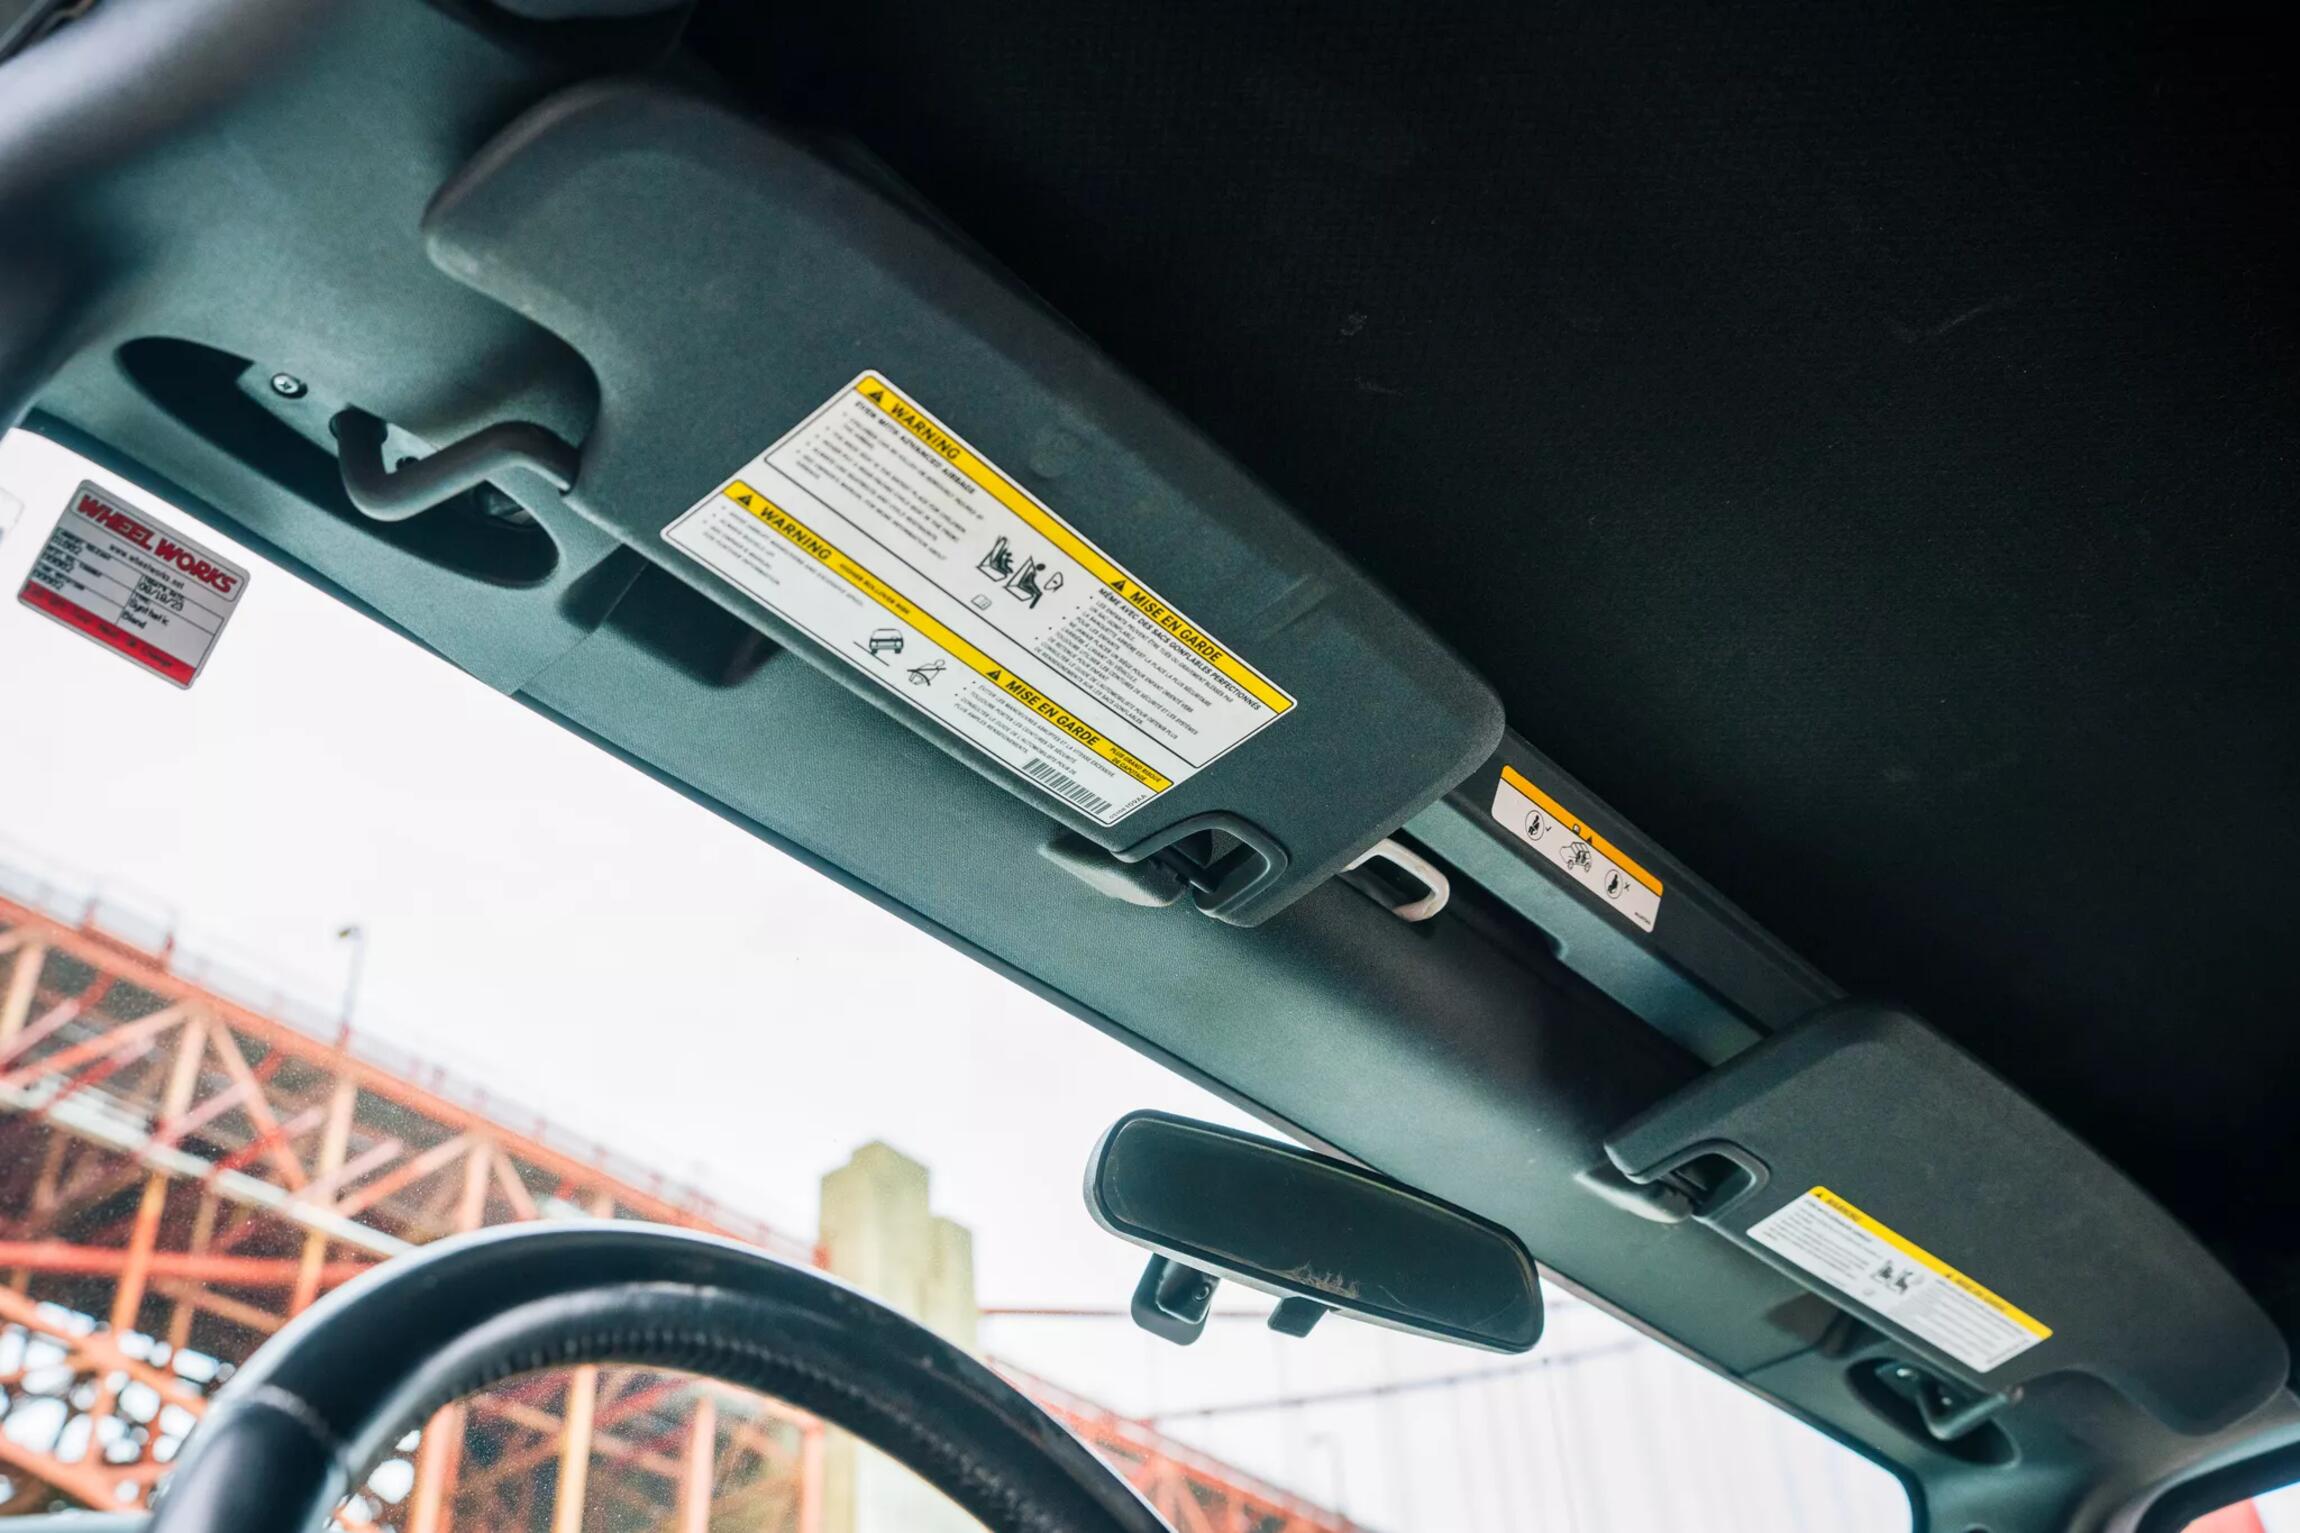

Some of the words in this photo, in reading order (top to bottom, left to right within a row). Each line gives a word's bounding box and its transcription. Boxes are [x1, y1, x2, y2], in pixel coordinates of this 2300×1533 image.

[887, 402, 963, 460] WARNING
[75, 493, 159, 552] WHEEL
[153, 537, 238, 596] WORKS
[756, 506, 834, 560] WARNING
[1097, 587, 1121, 605] MÊME
[1119, 603, 1141, 620] AVEC
[1136, 617, 1155, 630] DES
[1151, 627, 1172, 643] SACS
[1168, 640, 1213, 674] GONFLABLES
[1209, 671, 1262, 710] PERFECTIONNÉS
[1128, 590, 1166, 618] MISE
[1159, 614, 1183, 631] EN
[1177, 627, 1223, 662] GARDE
[1004, 680, 1041, 705] MISE
[1036, 701, 1059, 717] EN
[1054, 714, 1100, 745] GARDE
[1109, 747, 1125, 758] PLUS
[1122, 756, 1143, 770] GRAND
[1140, 768, 1161, 782] RISQUE
[1118, 762, 1146, 781] CAPOTAGE
